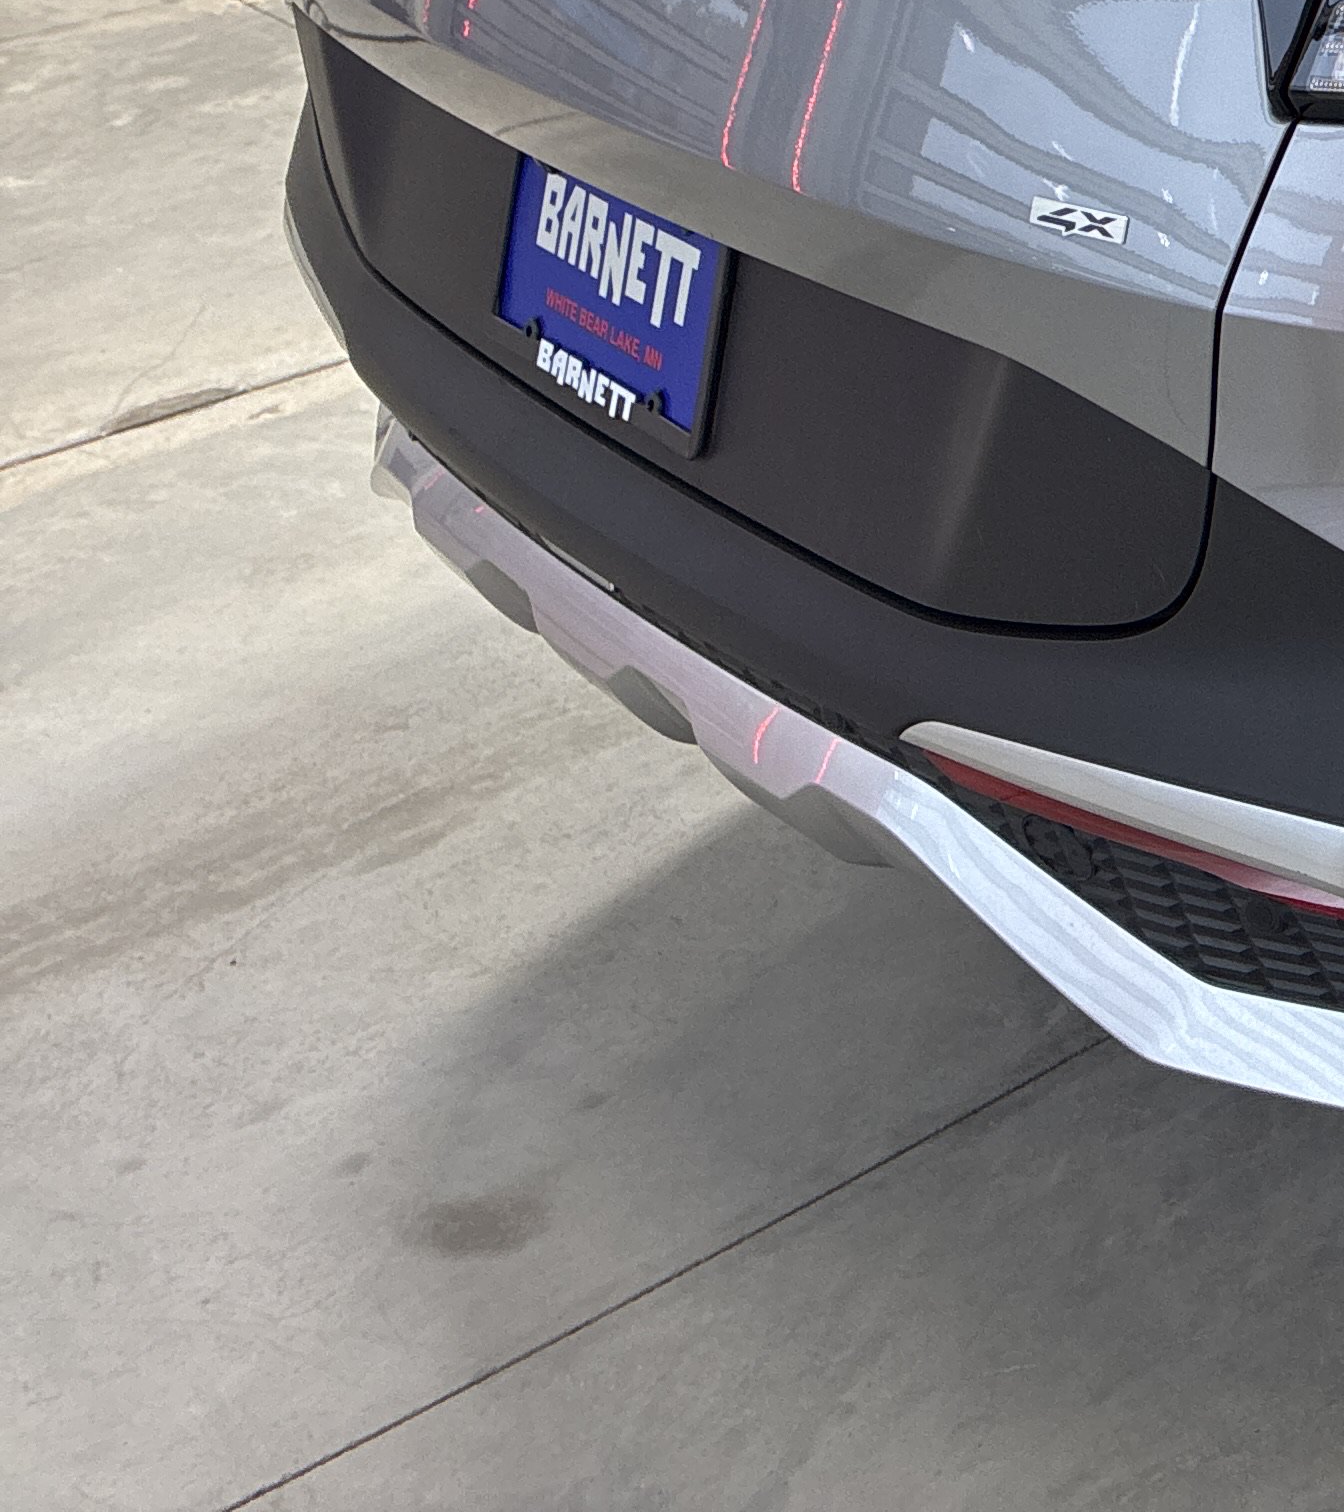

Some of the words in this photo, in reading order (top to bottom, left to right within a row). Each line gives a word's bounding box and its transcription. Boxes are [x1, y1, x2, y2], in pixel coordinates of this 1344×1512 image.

[535, 171, 701, 329] BARNETT
[545, 287, 578, 323] WHITE
[579, 307, 609, 341] BEAR
[609, 325, 641, 362] LAKE,
[643, 345, 663, 372] MN
[536, 338, 637, 422] BARNETT
